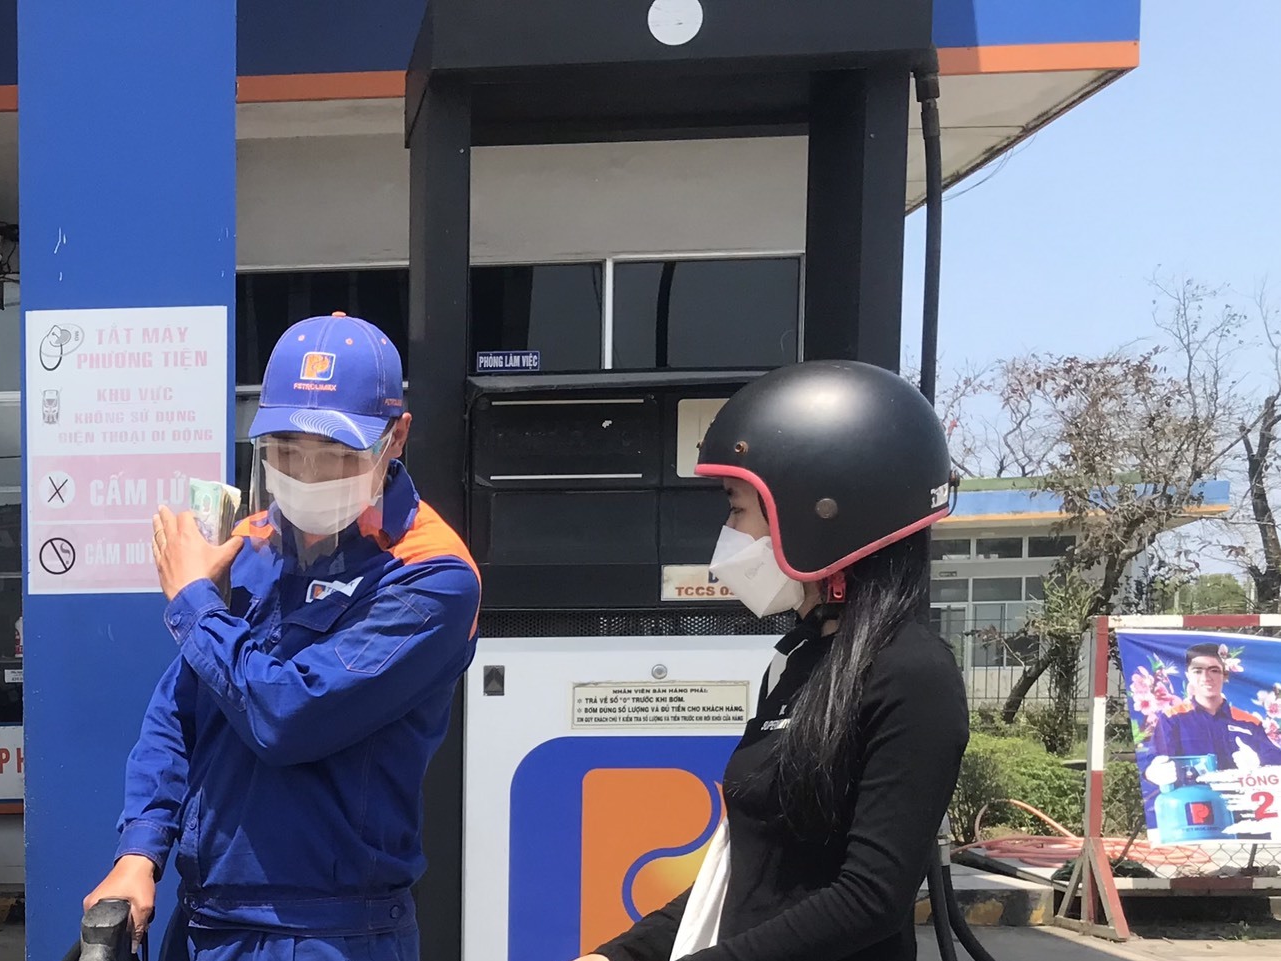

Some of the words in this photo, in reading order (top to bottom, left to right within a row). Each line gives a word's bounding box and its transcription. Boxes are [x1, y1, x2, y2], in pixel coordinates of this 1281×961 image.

[95, 322, 134, 345] TẮT
[142, 324, 189, 344] MÁY
[77, 350, 153, 369] PHƯƠNG
[162, 348, 208, 370] TIỆN
[479, 353, 503, 368] PHÒNG
[505, 353, 520, 367] LÀM
[522, 353, 538, 370] VIỆC
[97, 388, 131, 402] KHU
[138, 386, 174, 404] VỰC
[74, 410, 124, 424] KHÔNG
[89, 470, 147, 507] CẤM
[157, 469, 189, 505] LỬ
[85, 537, 120, 565] CẤM
[675, 586, 715, 597] TCCS
